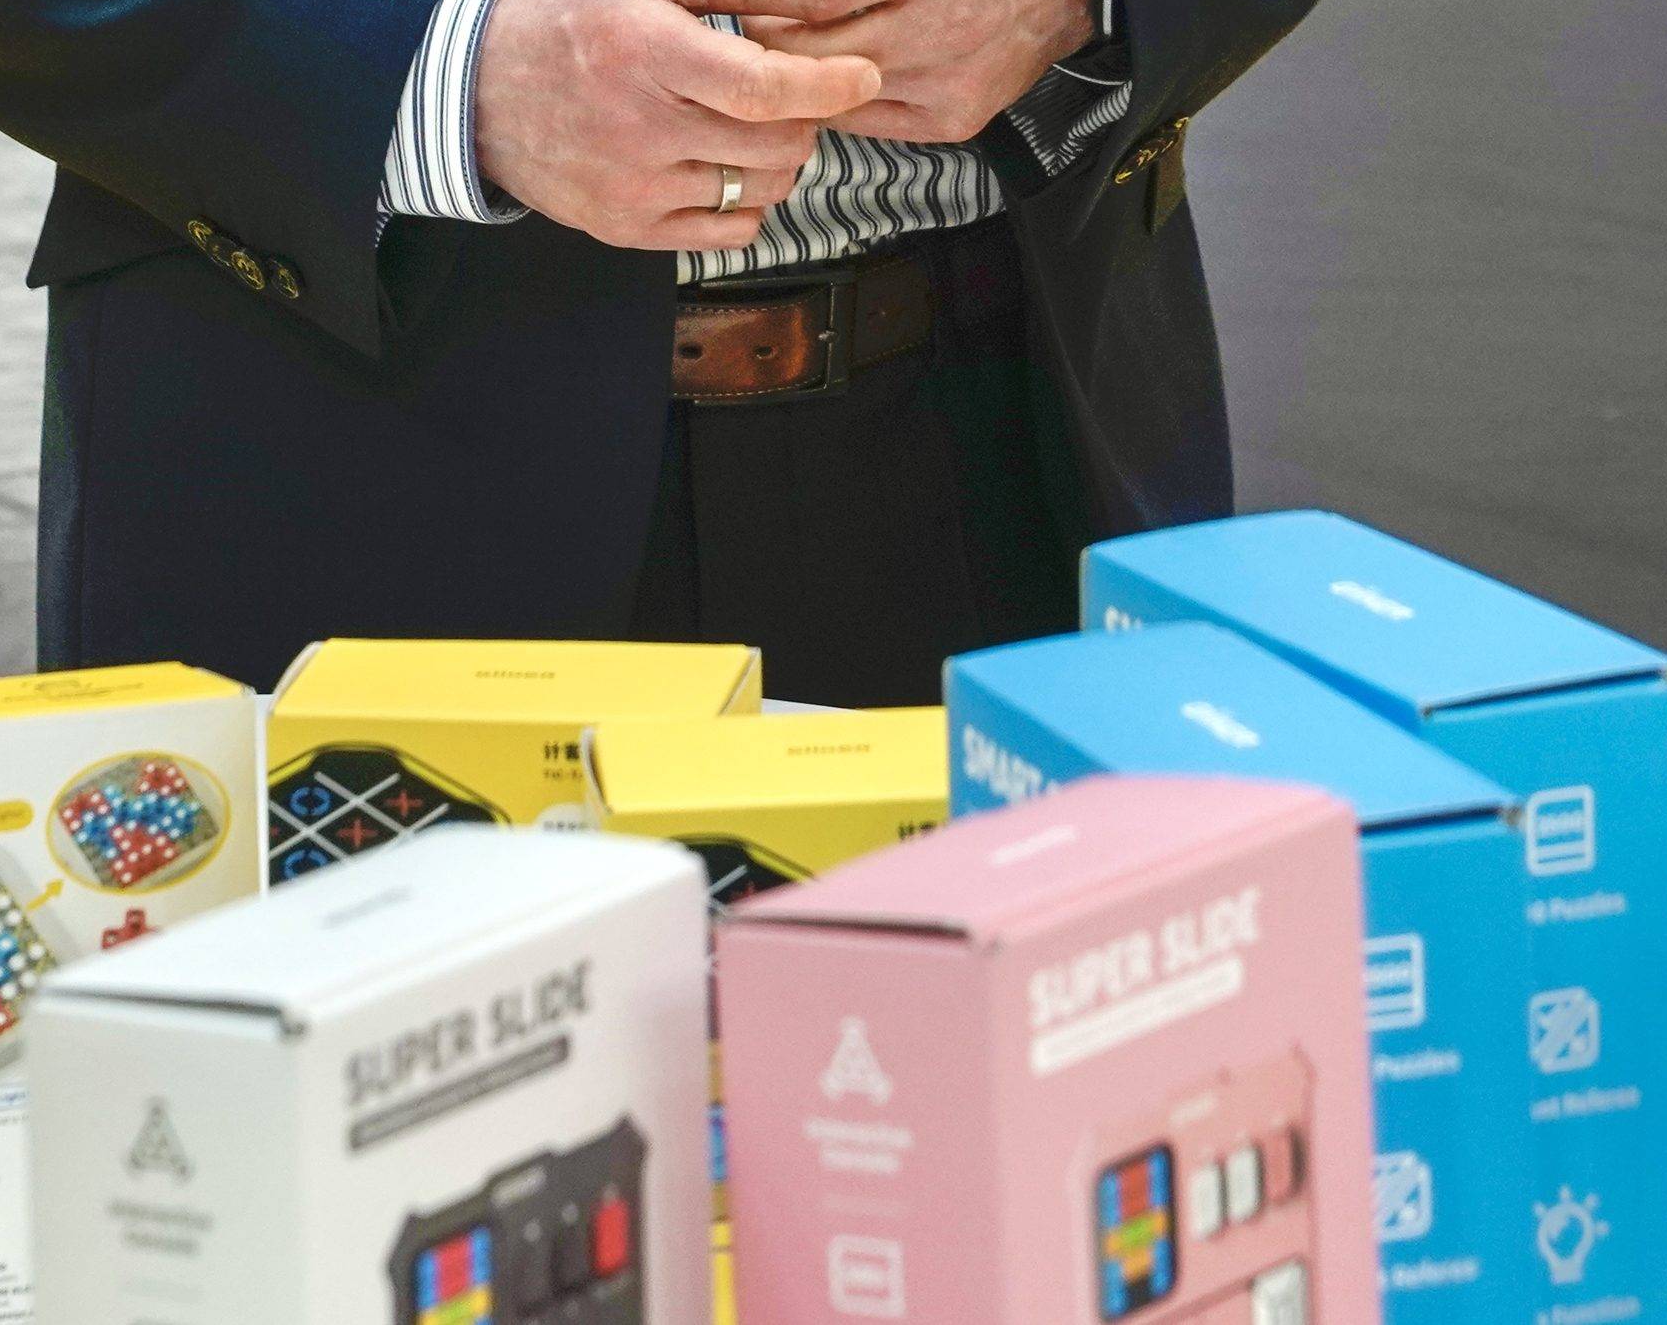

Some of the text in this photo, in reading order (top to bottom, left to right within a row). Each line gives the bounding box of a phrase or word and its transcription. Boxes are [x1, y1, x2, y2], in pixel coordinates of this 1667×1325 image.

[1027, 884, 1262, 1027] SUPER SLIDE
[344, 957, 592, 1106] SUPER SLIDE
